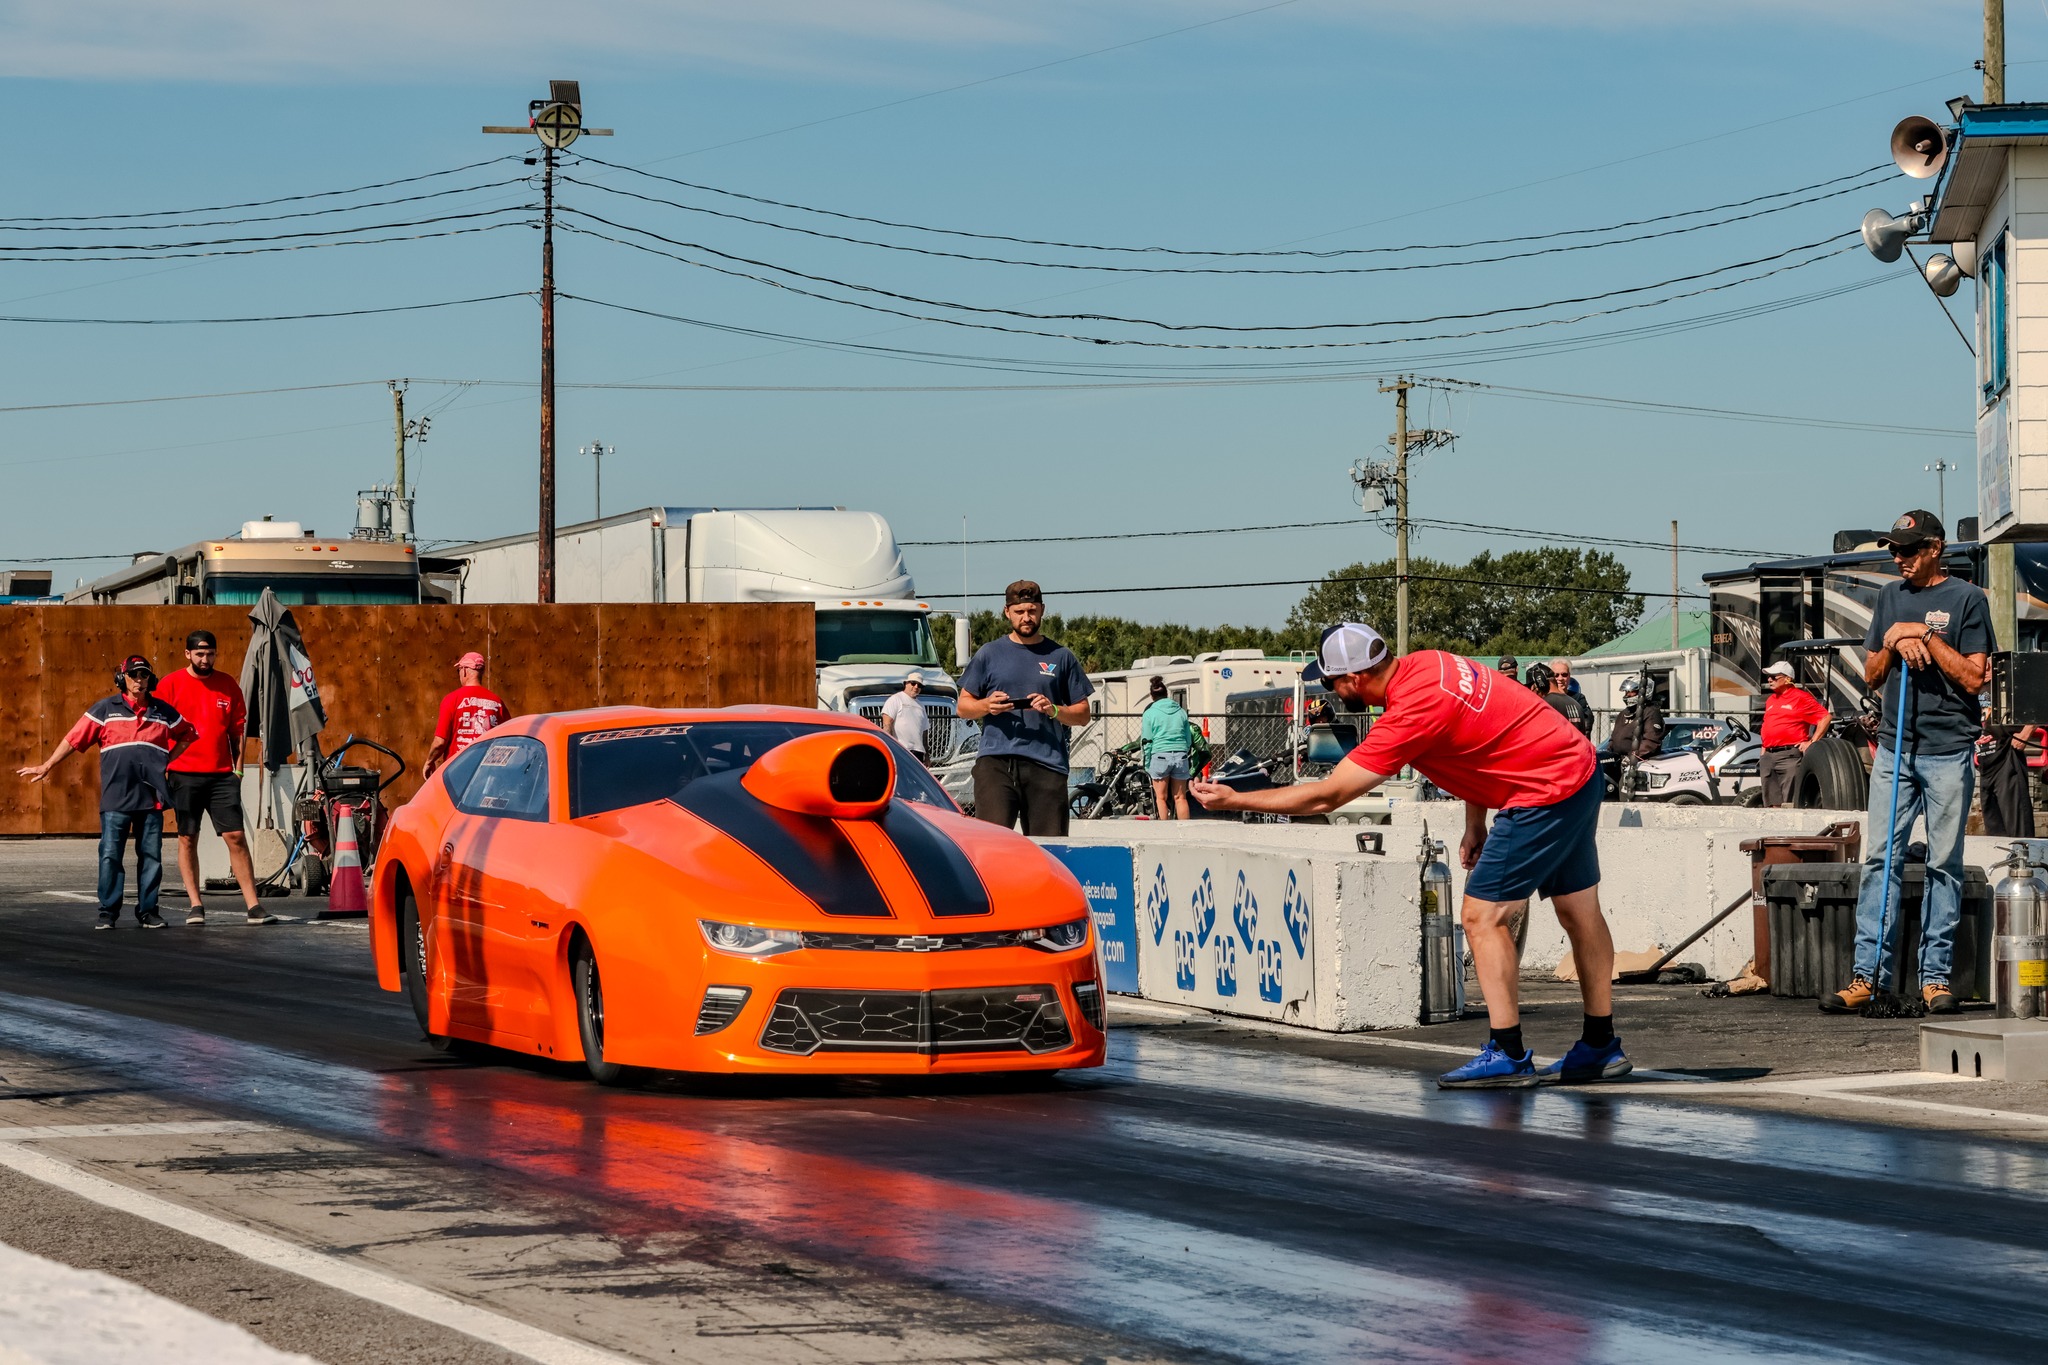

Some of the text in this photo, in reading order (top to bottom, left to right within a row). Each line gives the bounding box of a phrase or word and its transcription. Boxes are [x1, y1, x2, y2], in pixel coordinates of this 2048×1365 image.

[1692, 731, 1719, 739] 1407
[1101, 881, 1117, 900] d'auto
[1148, 871, 1167, 935] PPG
[1192, 875, 1214, 936] PPG
[1235, 876, 1257, 942] PPG
[1284, 876, 1309, 949] PPG
[1175, 940, 1195, 981] PPG
[1215, 946, 1236, 987] PPG
[1258, 950, 1282, 993] PPG
